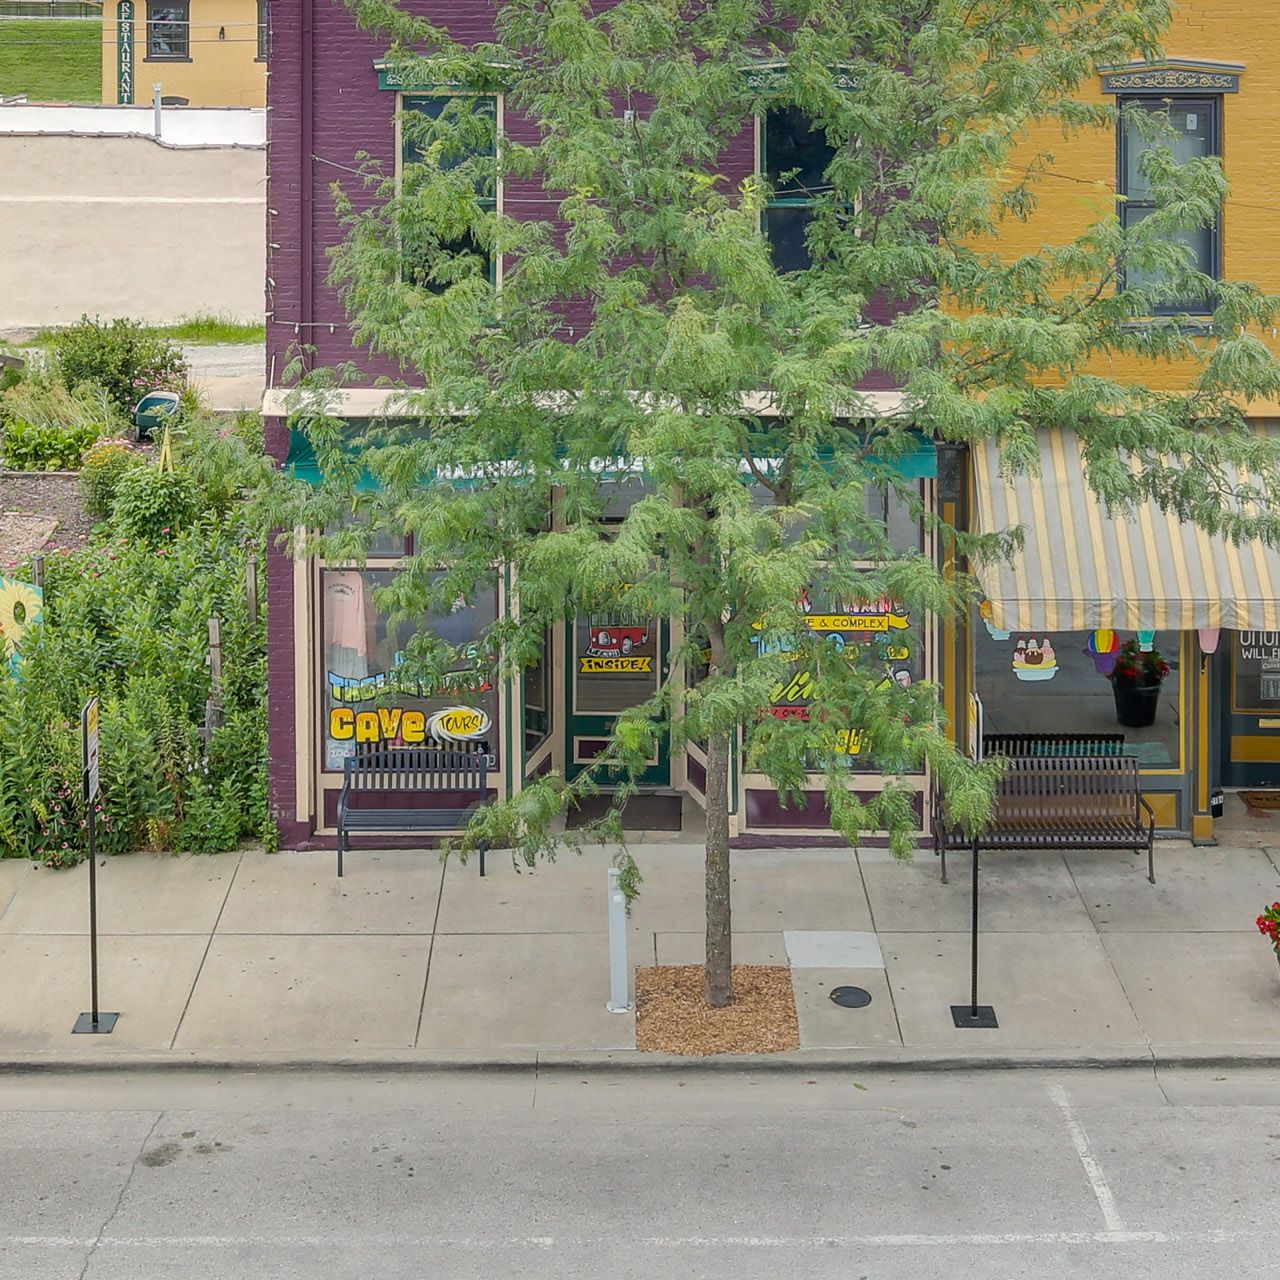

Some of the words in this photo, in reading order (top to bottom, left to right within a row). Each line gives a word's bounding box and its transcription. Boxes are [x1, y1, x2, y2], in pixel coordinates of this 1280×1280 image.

[121, 2, 131, 104] RESTAURANT
[560, 456, 653, 473] TOLLE
[832, 617, 885, 628] COMPLEX
[1241, 647, 1268, 659] WILL
[438, 713, 484, 733] TOURS!
